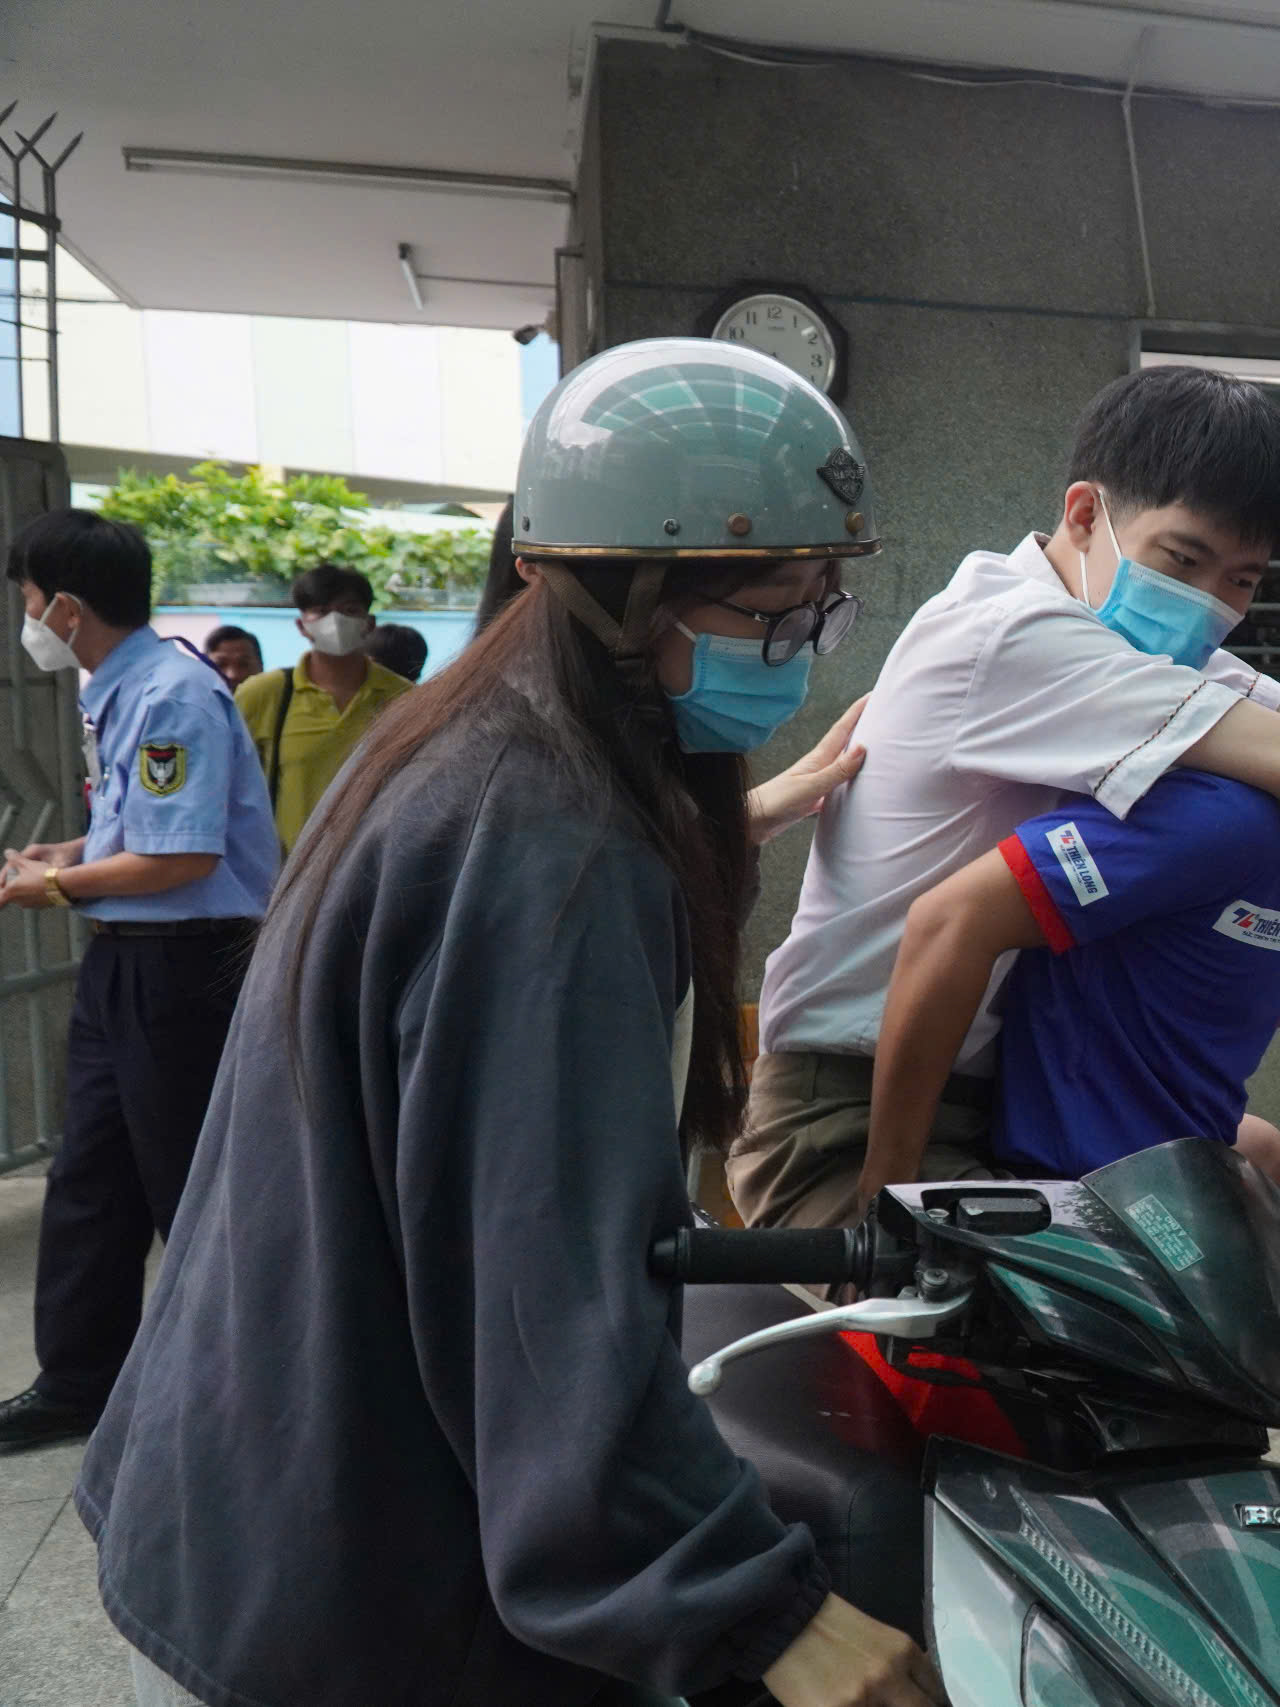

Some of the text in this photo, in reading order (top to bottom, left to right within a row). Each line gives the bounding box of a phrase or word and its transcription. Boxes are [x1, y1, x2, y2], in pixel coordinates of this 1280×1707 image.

[808, 333, 818, 345] 2
[811, 354, 823, 367] 3
[1079, 870, 1098, 894] LONG
